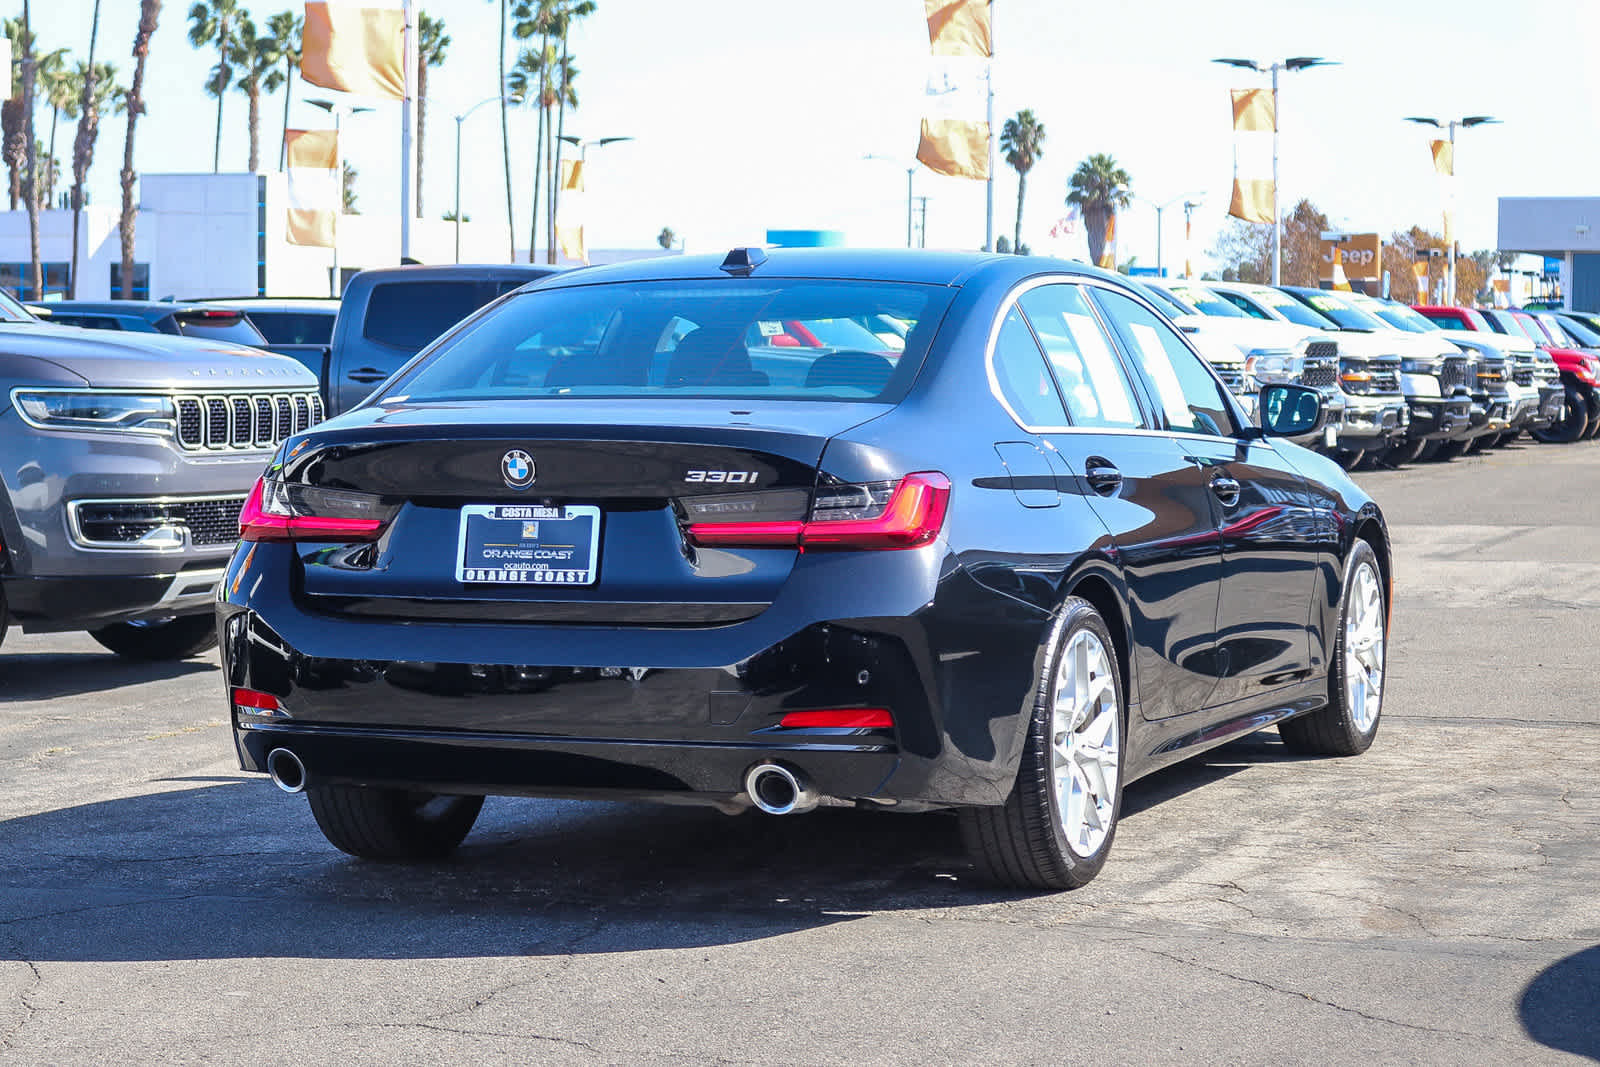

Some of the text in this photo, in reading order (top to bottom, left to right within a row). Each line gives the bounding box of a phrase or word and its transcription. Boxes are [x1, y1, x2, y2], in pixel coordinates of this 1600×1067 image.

[1322, 246, 1374, 267] Jeep
[502, 508, 558, 517] COSTA MESA
[483, 549, 574, 560] ORANGE COAST
[503, 562, 549, 570] ocauto.com
[466, 570, 586, 583] ORANGE COAST
